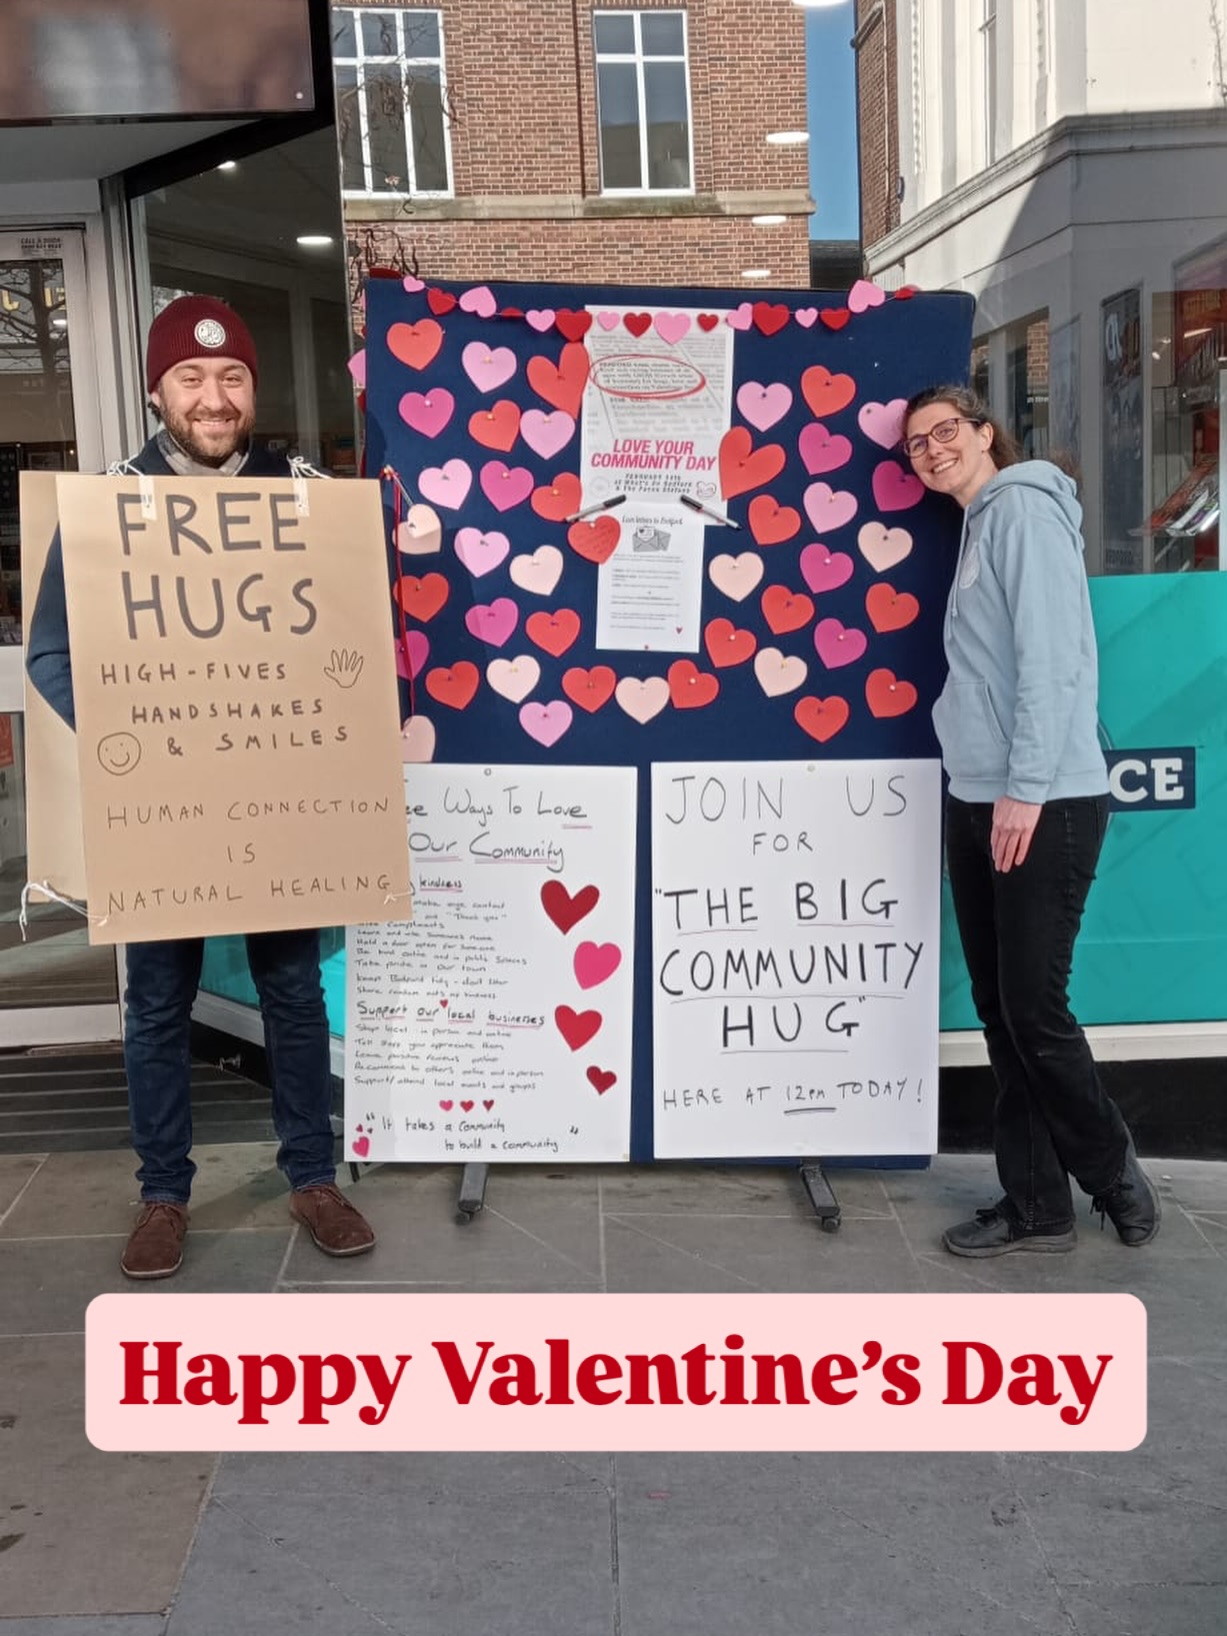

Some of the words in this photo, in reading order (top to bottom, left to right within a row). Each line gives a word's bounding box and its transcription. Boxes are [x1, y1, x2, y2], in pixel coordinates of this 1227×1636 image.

[591, 453, 683, 470] COMMUNITY
[686, 456, 717, 471] DAY
[613, 439, 651, 454] LOVE
[656, 440, 694, 455] YOUR
[116, 492, 306, 556] FREE
[122, 571, 318, 640] HUGS
[131, 699, 324, 725] HANDSHAKES
[167, 738, 184, 757] &
[215, 726, 350, 752] SMILES
[1109, 757, 1184, 803] CE
[106, 803, 205, 830] HUMAN
[226, 797, 390, 822] CONNECTION
[443, 786, 494, 827] Ways
[502, 785, 523, 815] To
[536, 791, 588, 819] Love
[665, 775, 784, 825] JOIN
[845, 775, 907, 818] US
[227, 842, 258, 865] IS
[408, 832, 459, 853] Our
[468, 831, 565, 874] Community
[752, 831, 814, 856] FOR
[107, 883, 245, 915] NATURAL
[270, 874, 392, 898] HEALING
[795, 878, 899, 922] BIG
[659, 941, 924, 996] COMMUNITY
[357, 1001, 408, 1017] Support
[447, 1009, 476, 1019] local
[488, 1010, 545, 1026] businesses
[662, 1087, 723, 1111] HERE
[745, 1085, 772, 1106] AT
[405, 1117, 435, 1132] takes
[444, 1123, 452, 1132] a
[445, 1140, 455, 1151] to
[459, 1139, 482, 1151] build
